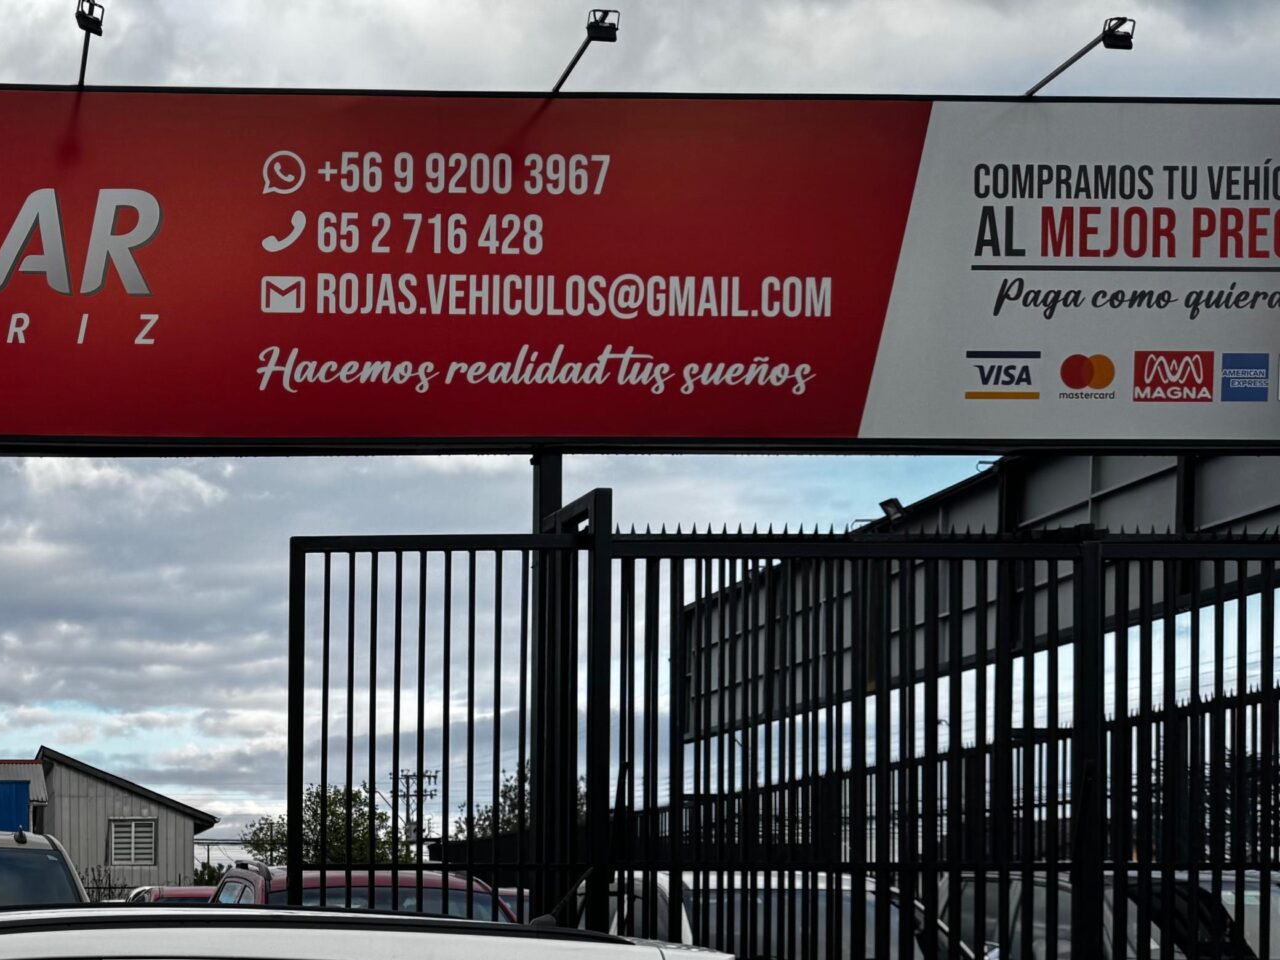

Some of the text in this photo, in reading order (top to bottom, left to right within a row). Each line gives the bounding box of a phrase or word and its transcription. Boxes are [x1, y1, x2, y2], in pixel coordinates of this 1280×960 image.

[317, 151, 611, 196] +56 9 9200 3967
[974, 163, 1154, 200] COMPRAMOS
[1162, 165, 1198, 201] TU
[317, 211, 544, 256] 65 2 716 428
[974, 205, 1280, 259] AL MEJOR PRE
[316, 272, 832, 320] ROJAS.VEHICULOS@GMAIL.COM
[992, 277, 1085, 320] Paga
[1091, 289, 1178, 309] como
[256, 343, 816, 395] Hacemos realidad tus sueños
[974, 365, 1032, 386] VISA
[1222, 368, 1266, 378] AMERICAN
[1059, 391, 1115, 400] mastercard
[1134, 386, 1212, 400] MAGNA
